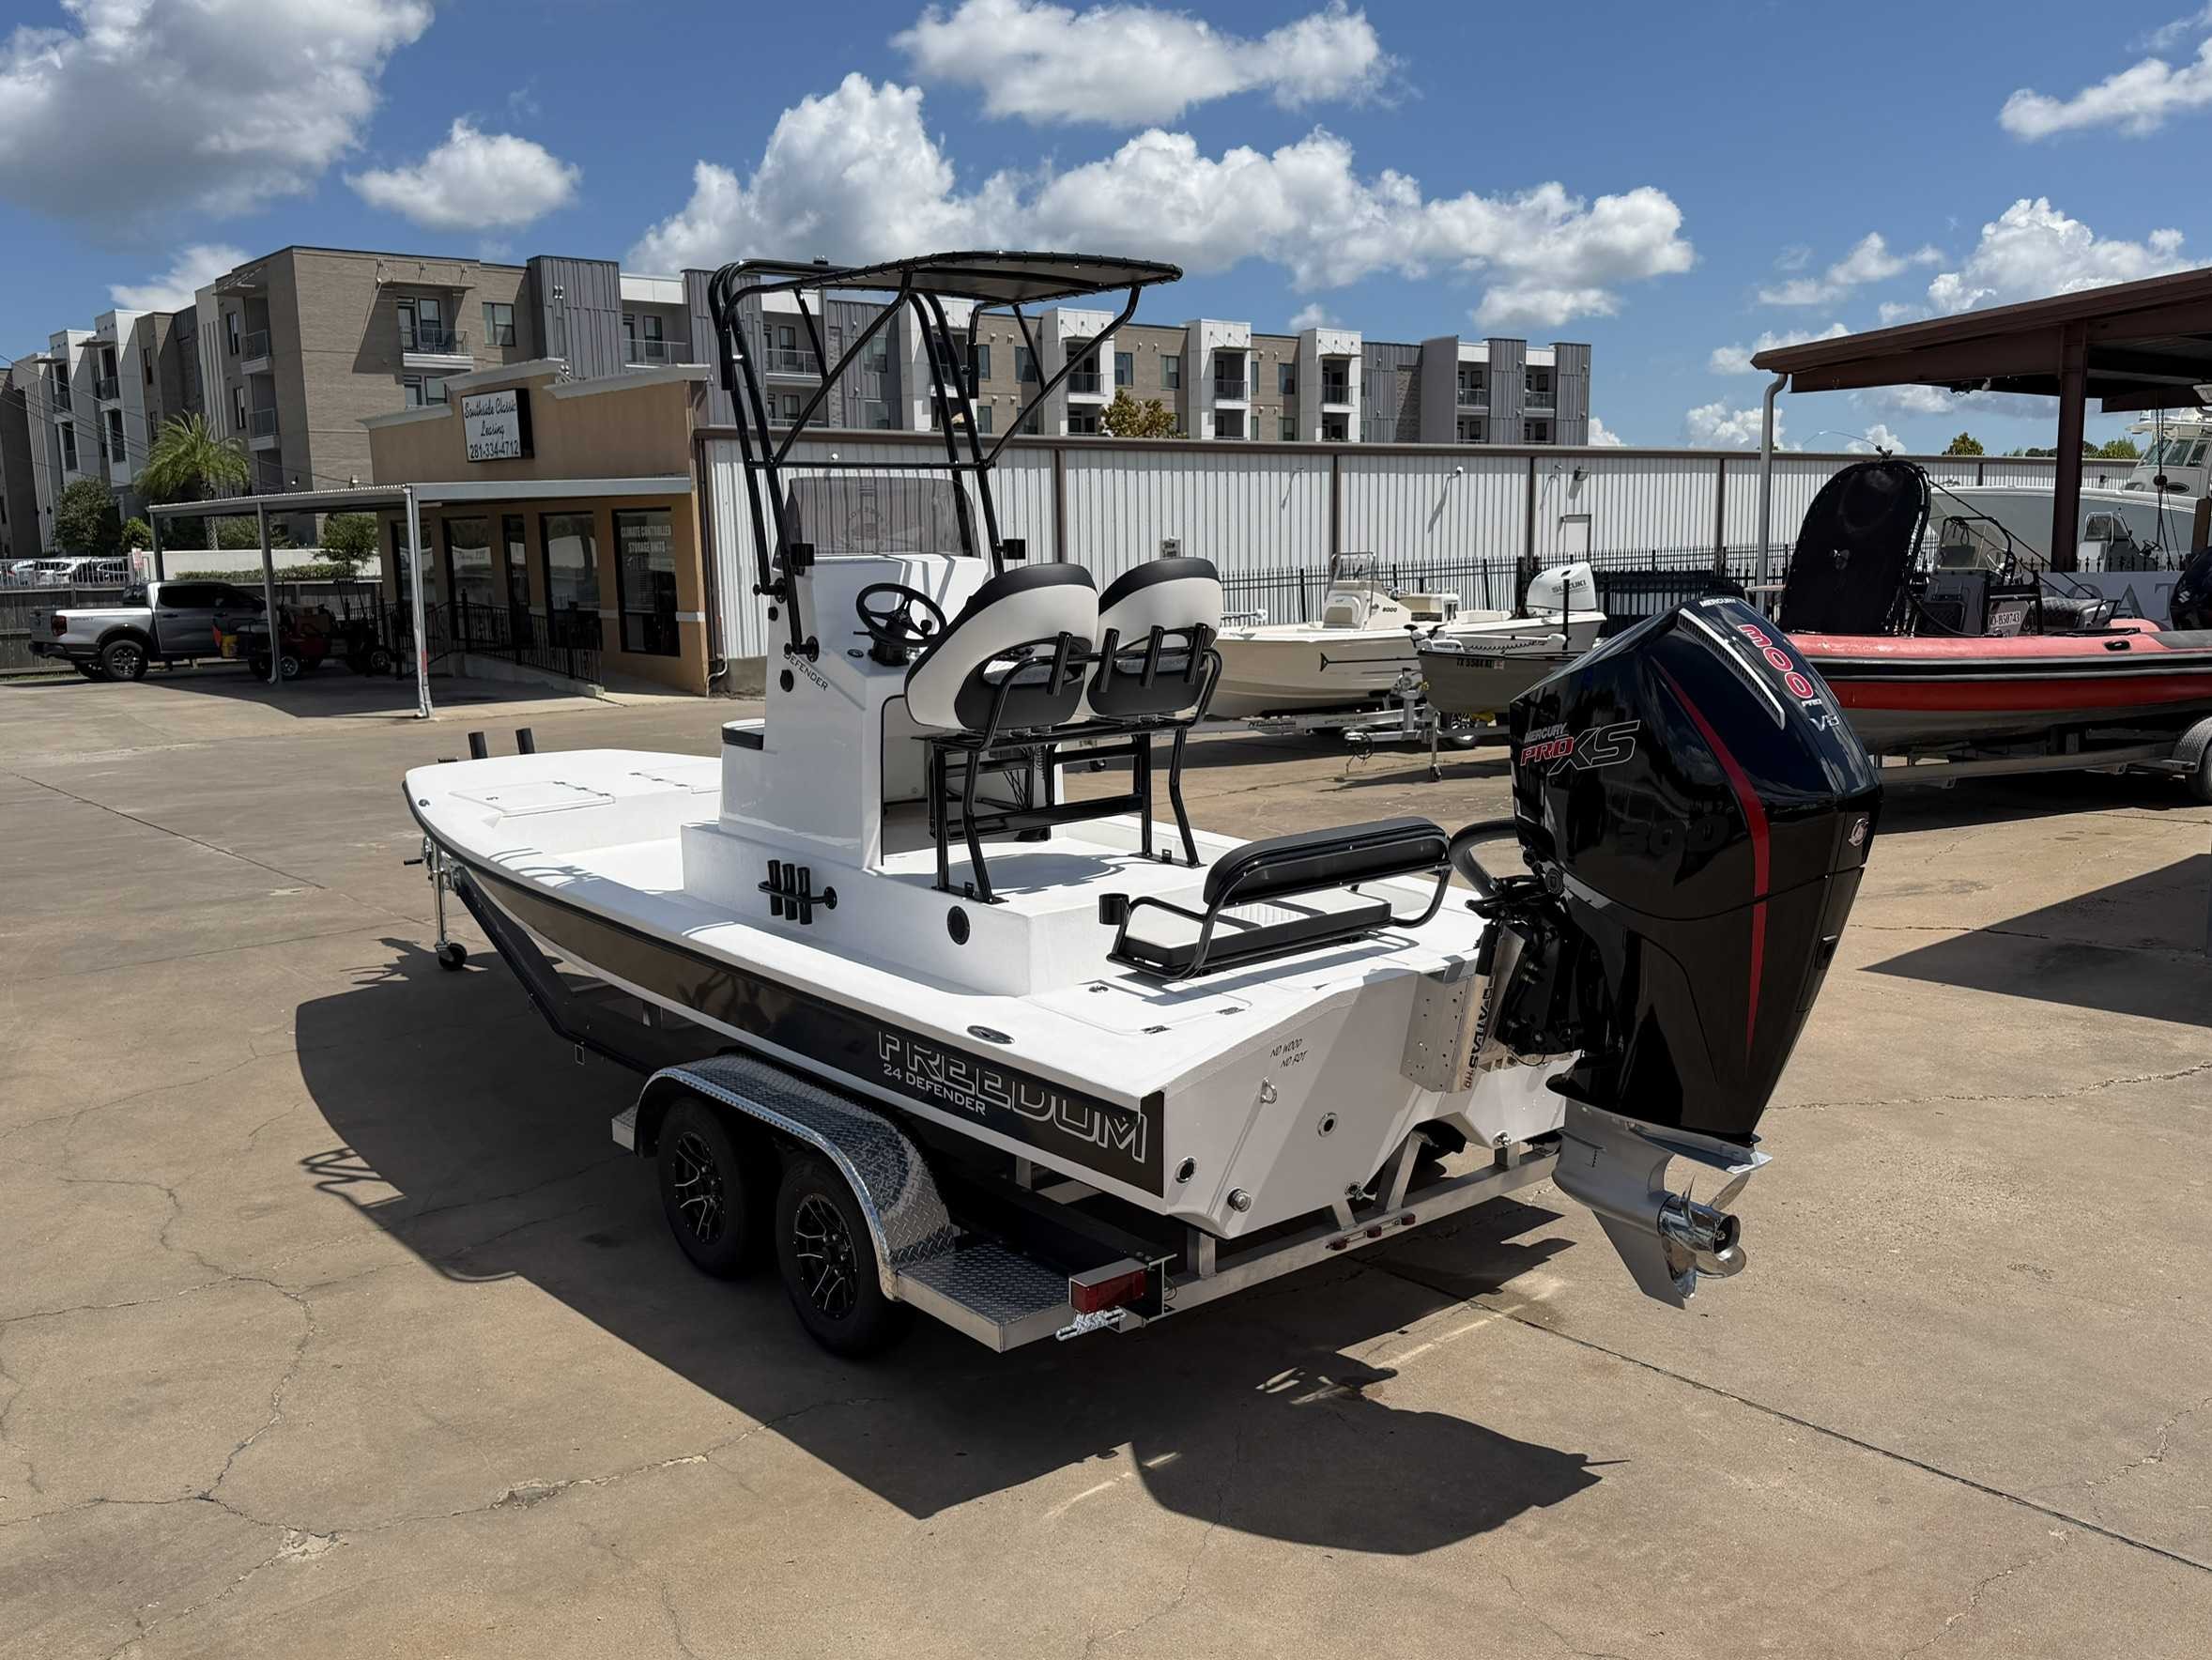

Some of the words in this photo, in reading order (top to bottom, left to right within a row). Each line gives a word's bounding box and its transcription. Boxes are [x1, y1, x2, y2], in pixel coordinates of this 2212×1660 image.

[783, 653, 828, 692] DEFENDER
[1524, 722, 1569, 744] MERCURY
[1269, 1044, 1283, 1058] NO
[1280, 1056, 1293, 1068] NO
[883, 1062, 902, 1081] 24
[905, 1071, 986, 1116] DEFENDER
